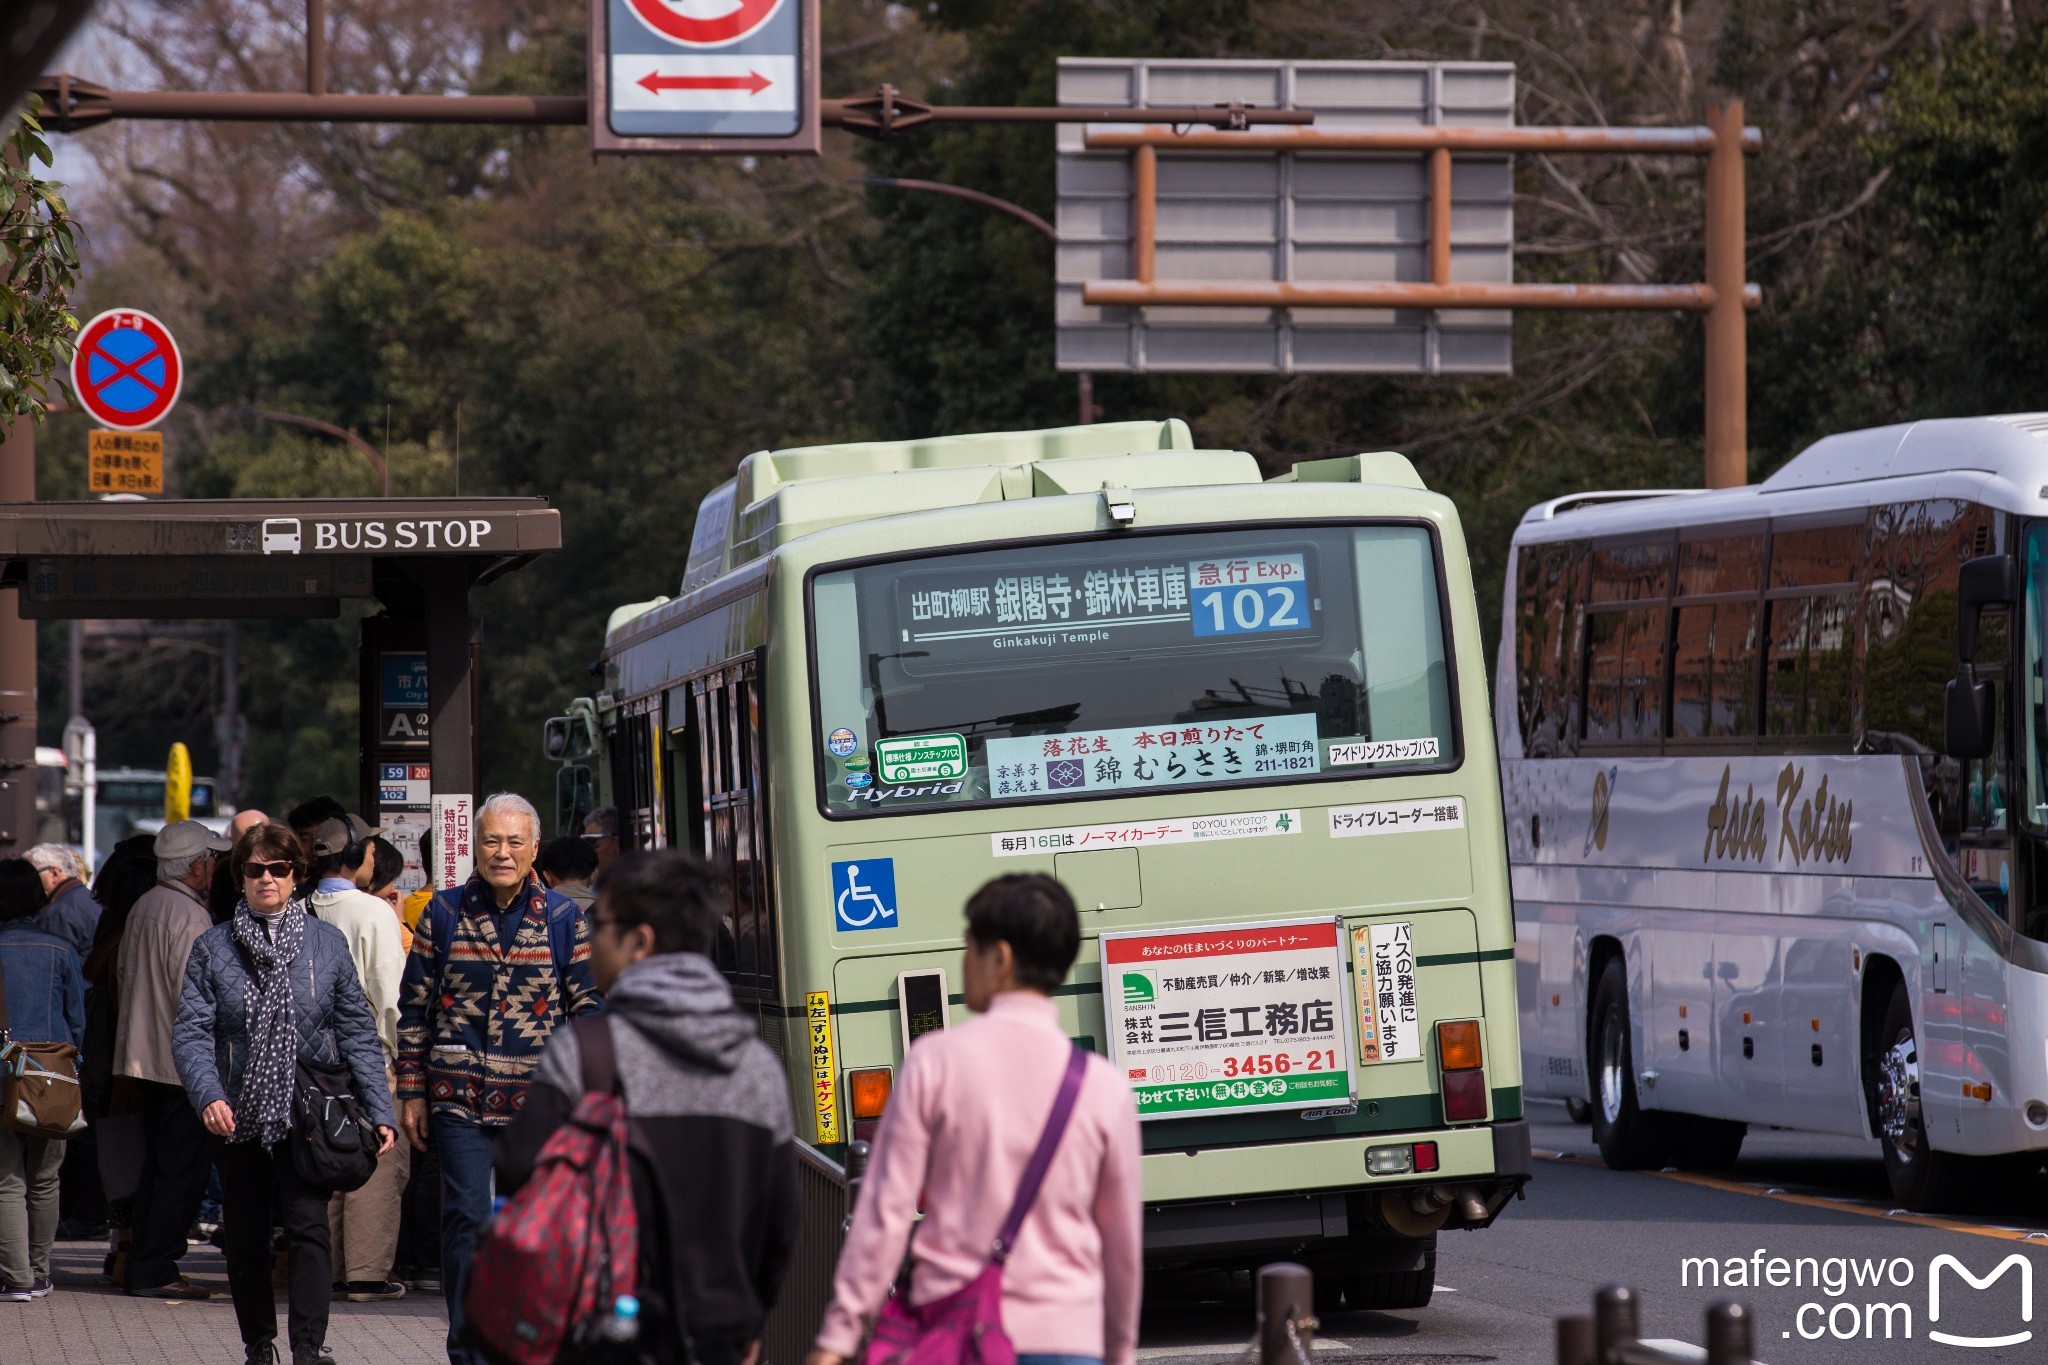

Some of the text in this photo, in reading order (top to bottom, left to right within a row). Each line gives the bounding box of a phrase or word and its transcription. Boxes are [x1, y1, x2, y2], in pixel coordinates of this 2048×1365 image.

[314, 519, 492, 549] BUS STOP
[911, 561, 1298, 623] 出町柳駅 銀閣寺・錦林車庫 急行 Exp.
[1201, 586, 1299, 632] 102
[993, 630, 1109, 648] Ginkakuji Temple
[388, 712, 416, 737] A
[1043, 723, 1265, 758] 落花生 本日煎りたて
[1332, 740, 1437, 763] アイドリングストップバス
[388, 767, 430, 778] 59 20
[996, 763, 1040, 779] 京菓子
[1255, 757, 1314, 772] 211-1821
[383, 791, 403, 799] 102
[847, 782, 964, 802] Hybrid
[998, 778, 1042, 795] 落花生
[1230, 815, 1267, 827] KYOTO?
[1332, 805, 1459, 829] ドライブレコーダー搭載
[1703, 760, 1853, 867] Asia Kotsu
[457, 800, 469, 857] テロ対策
[1001, 824, 1183, 852] 毎月16日は ノーマイカーデー
[1141, 936, 1309, 957] あなたの住まいづくりのパートナー
[1394, 924, 1416, 1023] バスの発進に
[1124, 1003, 1156, 1012] SANSHIN
[1375, 942, 1398, 1057] ご協力願います
[1124, 1015, 1154, 1031] 株式
[1158, 998, 1334, 1044] 三信工務店
[1125, 1030, 1154, 1045] 会社
[1151, 1049, 1336, 1083] 0120-3456-21
[1214, 1080, 1286, 1098] 無料査定
[1288, 1078, 1339, 1091] ご相談もお気軽に
[1302, 1107, 1356, 1118] AIR LOOP
